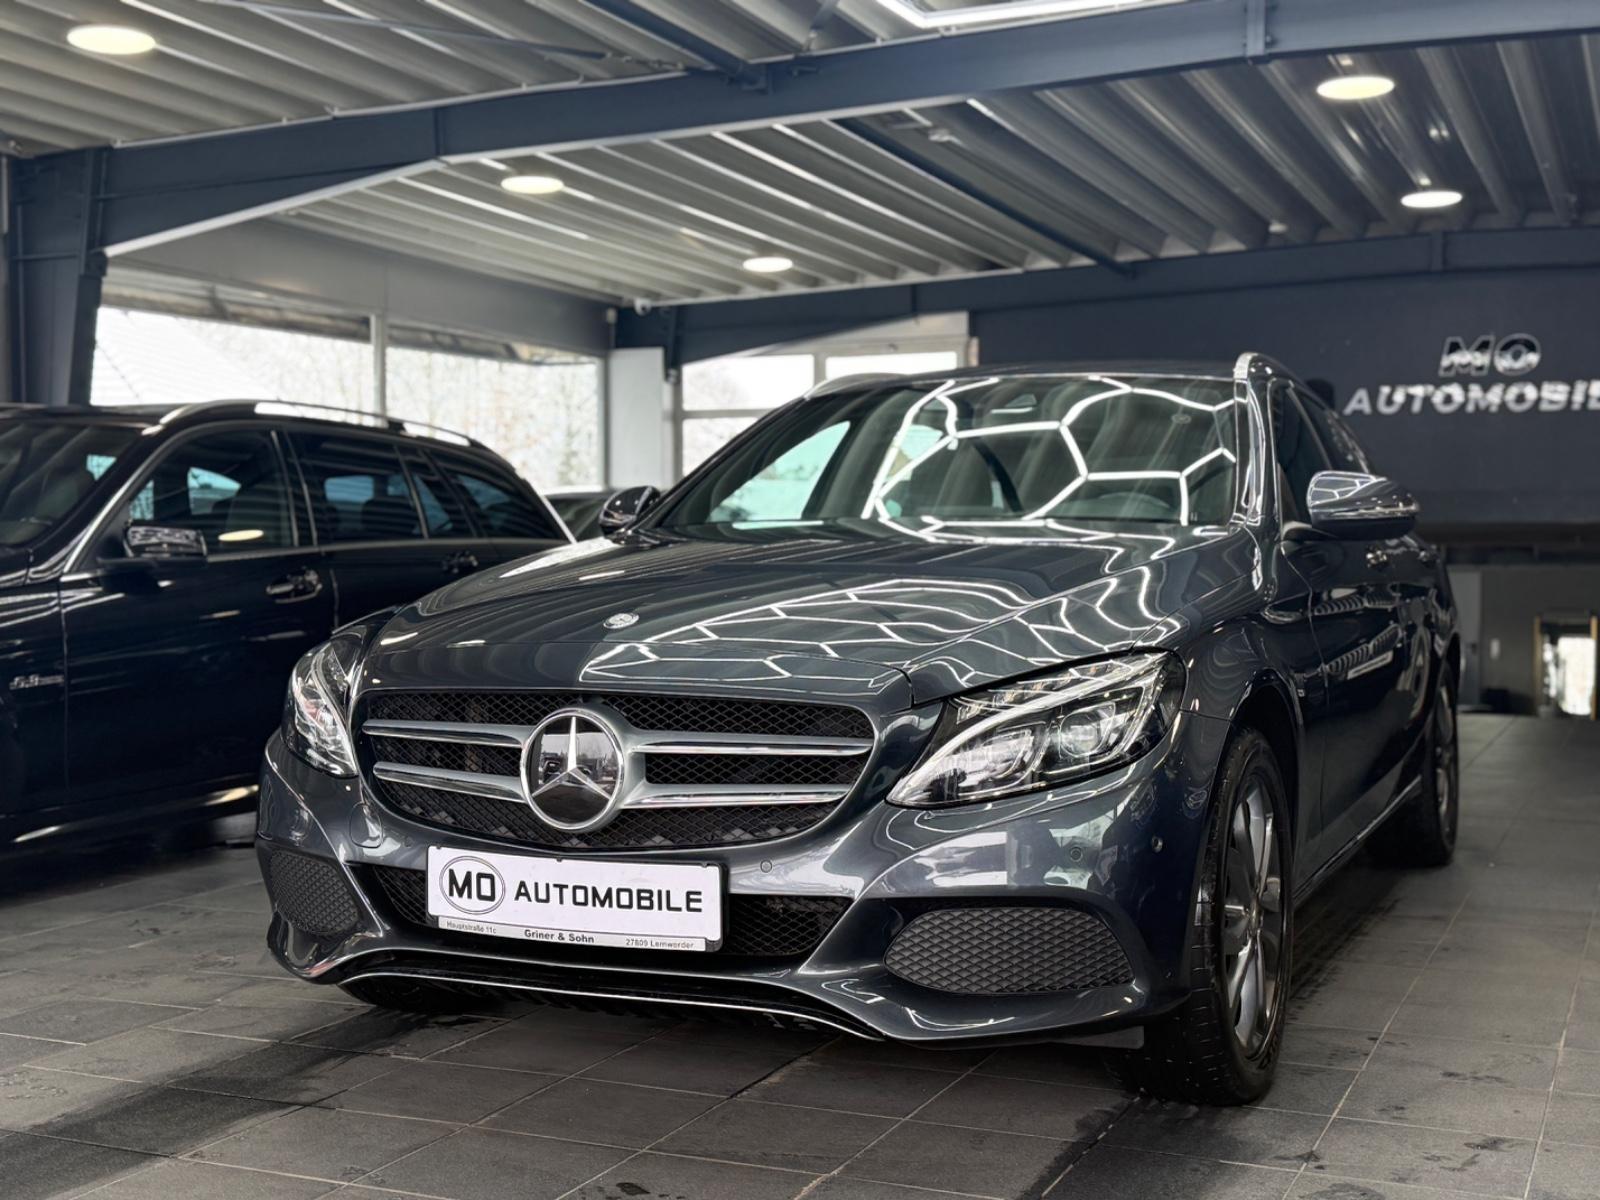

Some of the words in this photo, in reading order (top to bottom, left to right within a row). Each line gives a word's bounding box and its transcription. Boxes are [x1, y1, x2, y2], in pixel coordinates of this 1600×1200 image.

[1438, 333, 1541, 377] MO
[448, 869, 496, 902] MO
[514, 880, 703, 913] AUTOMOBILE
[524, 929, 554, 940] Griner
[557, 933, 565, 941] &
[568, 932, 595, 944] Sohn
